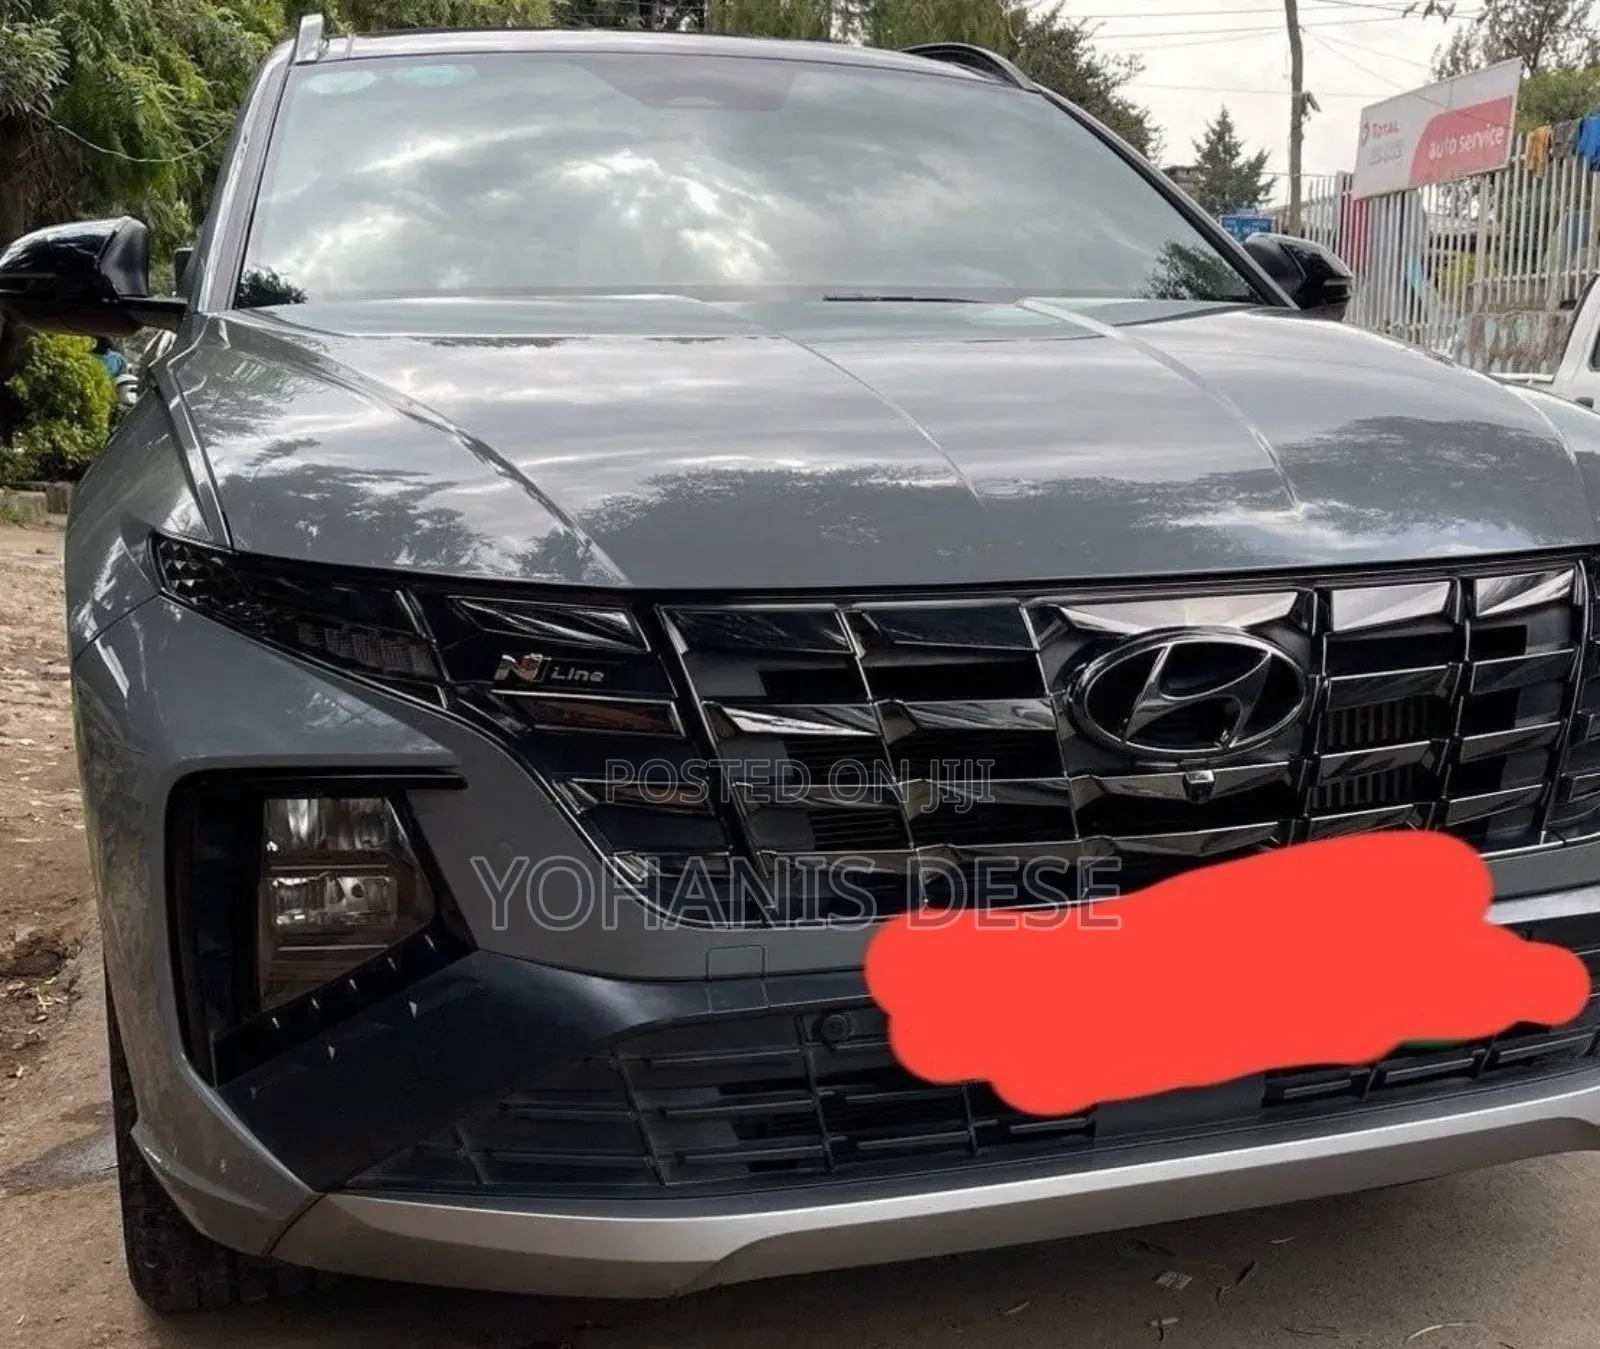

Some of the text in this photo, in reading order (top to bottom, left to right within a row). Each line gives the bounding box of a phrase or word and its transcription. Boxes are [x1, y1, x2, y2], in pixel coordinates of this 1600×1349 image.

[1429, 136, 1457, 160] auto
[1459, 123, 1505, 153] service
[551, 666, 605, 682] Line
